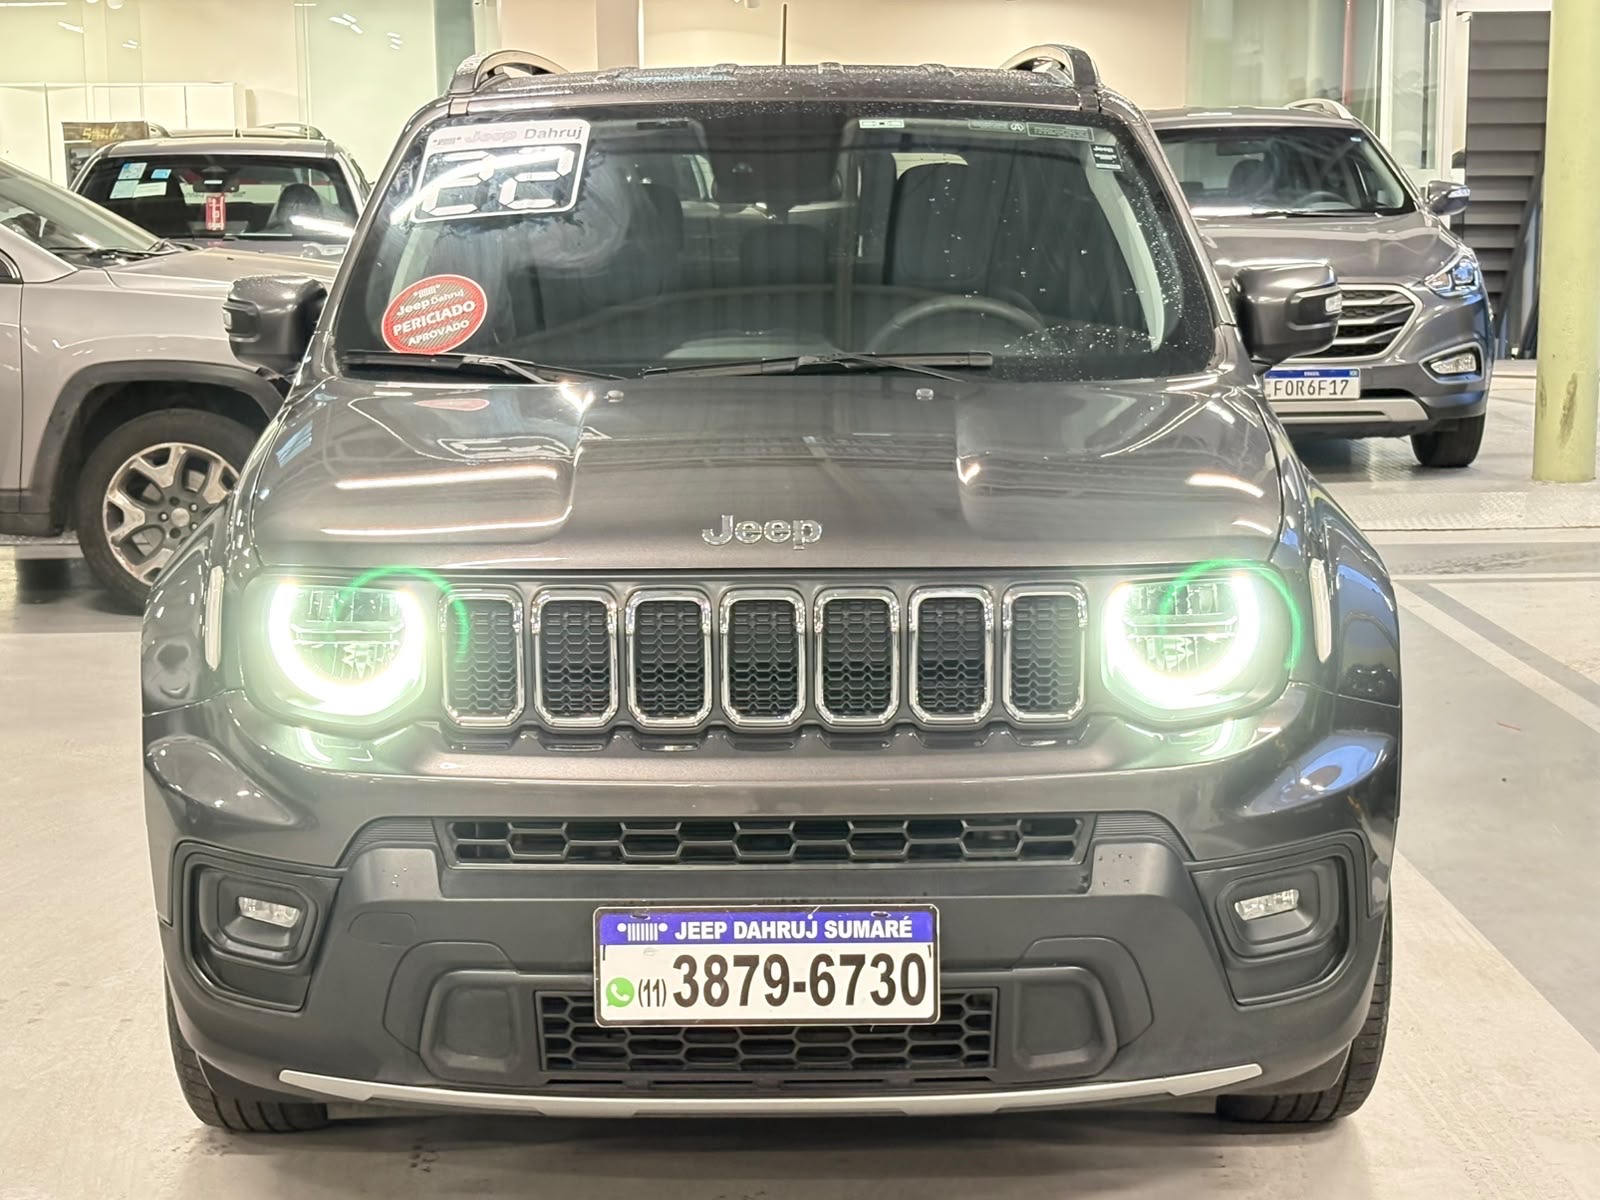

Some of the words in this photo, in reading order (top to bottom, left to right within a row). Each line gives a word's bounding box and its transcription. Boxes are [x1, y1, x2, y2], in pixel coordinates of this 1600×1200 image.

[524, 126, 584, 140] Dahruj
[421, 145, 575, 217] 22
[396, 300, 430, 316] Jeep
[430, 288, 464, 305] Dahruj
[393, 300, 476, 336] PERICIADO
[408, 319, 470, 346] APROVADO
[1273, 380, 1349, 397] FOR6F17
[702, 514, 822, 550] Jeep
[674, 921, 728, 940] JEEP
[733, 920, 819, 940] DAHRUJ
[826, 916, 913, 939] SUMARÉ
[638, 978, 668, 1008] (11)
[672, 952, 927, 1007] 3879-6730
